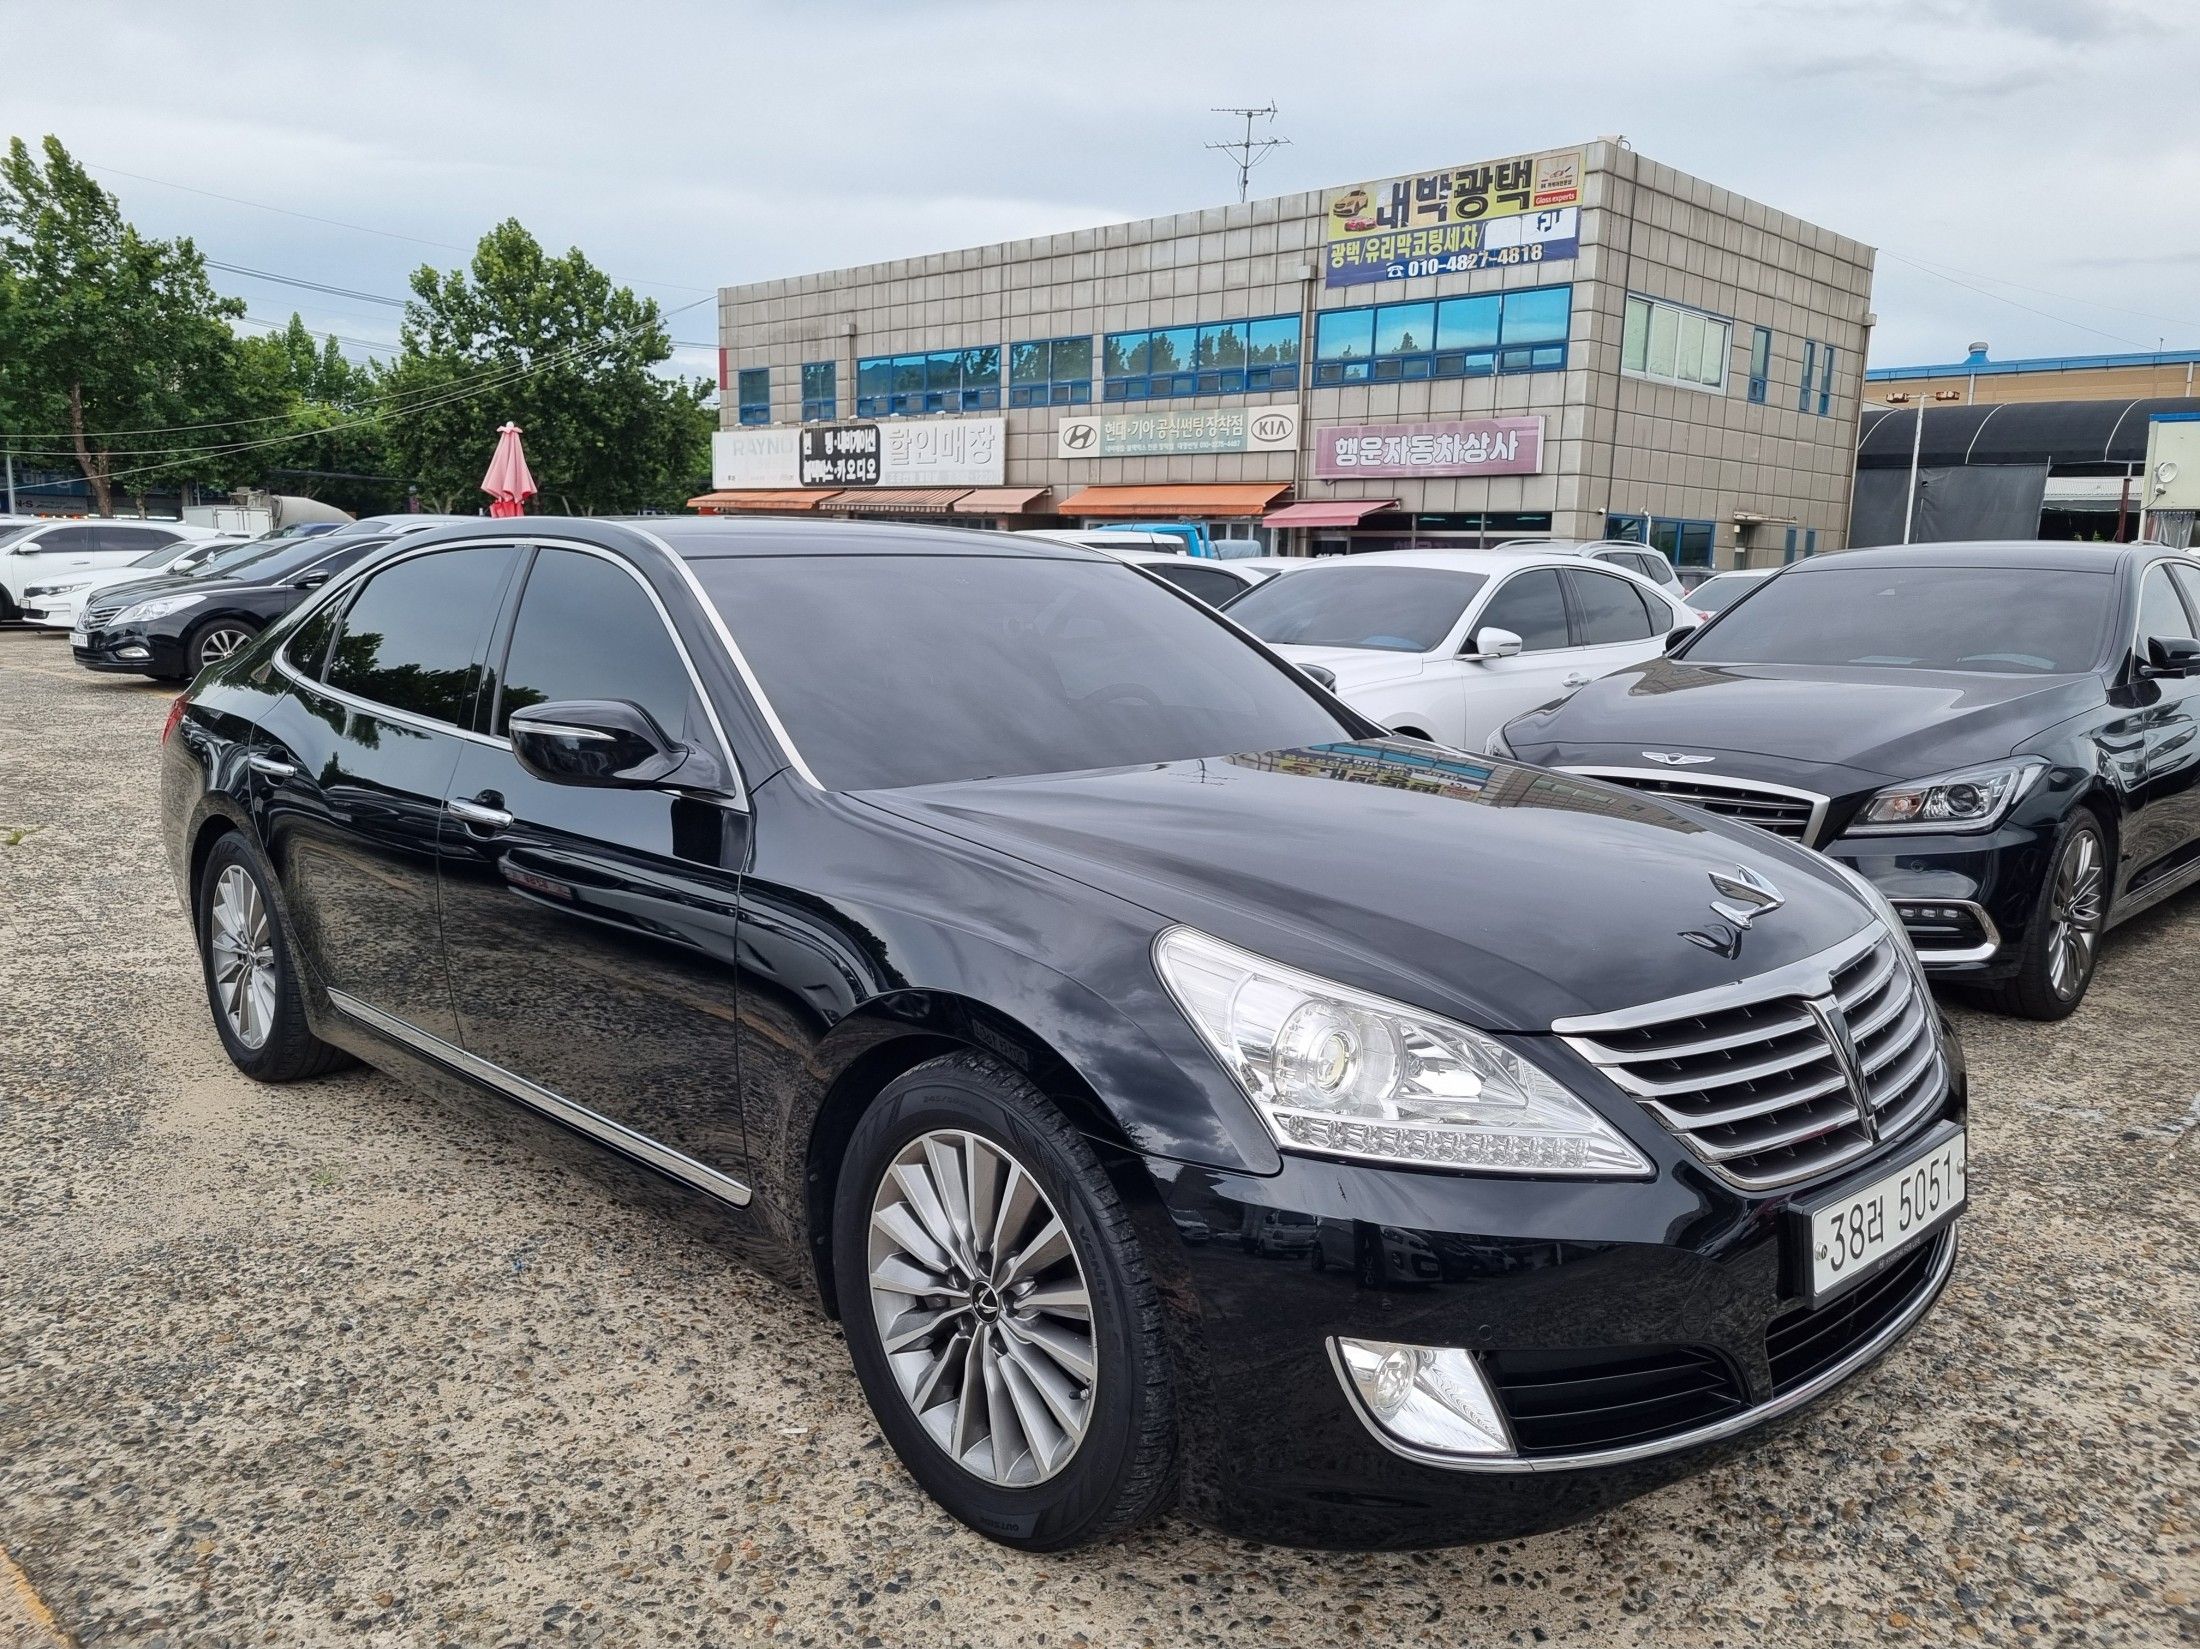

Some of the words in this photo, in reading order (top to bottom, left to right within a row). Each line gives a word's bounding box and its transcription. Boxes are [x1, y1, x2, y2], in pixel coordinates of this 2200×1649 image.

[1535, 196, 1552, 205] Gloss
[1552, 193, 1575, 203] experts
[1408, 244, 1543, 277] 010-4827-4818
[888, 424, 996, 466] 할인매장
[1258, 420, 1287, 436] KIA
[1335, 430, 1519, 467] 행운자동차상사
[1830, 1195, 1884, 1272] 38러
[1900, 1150, 1951, 1231] 5051
